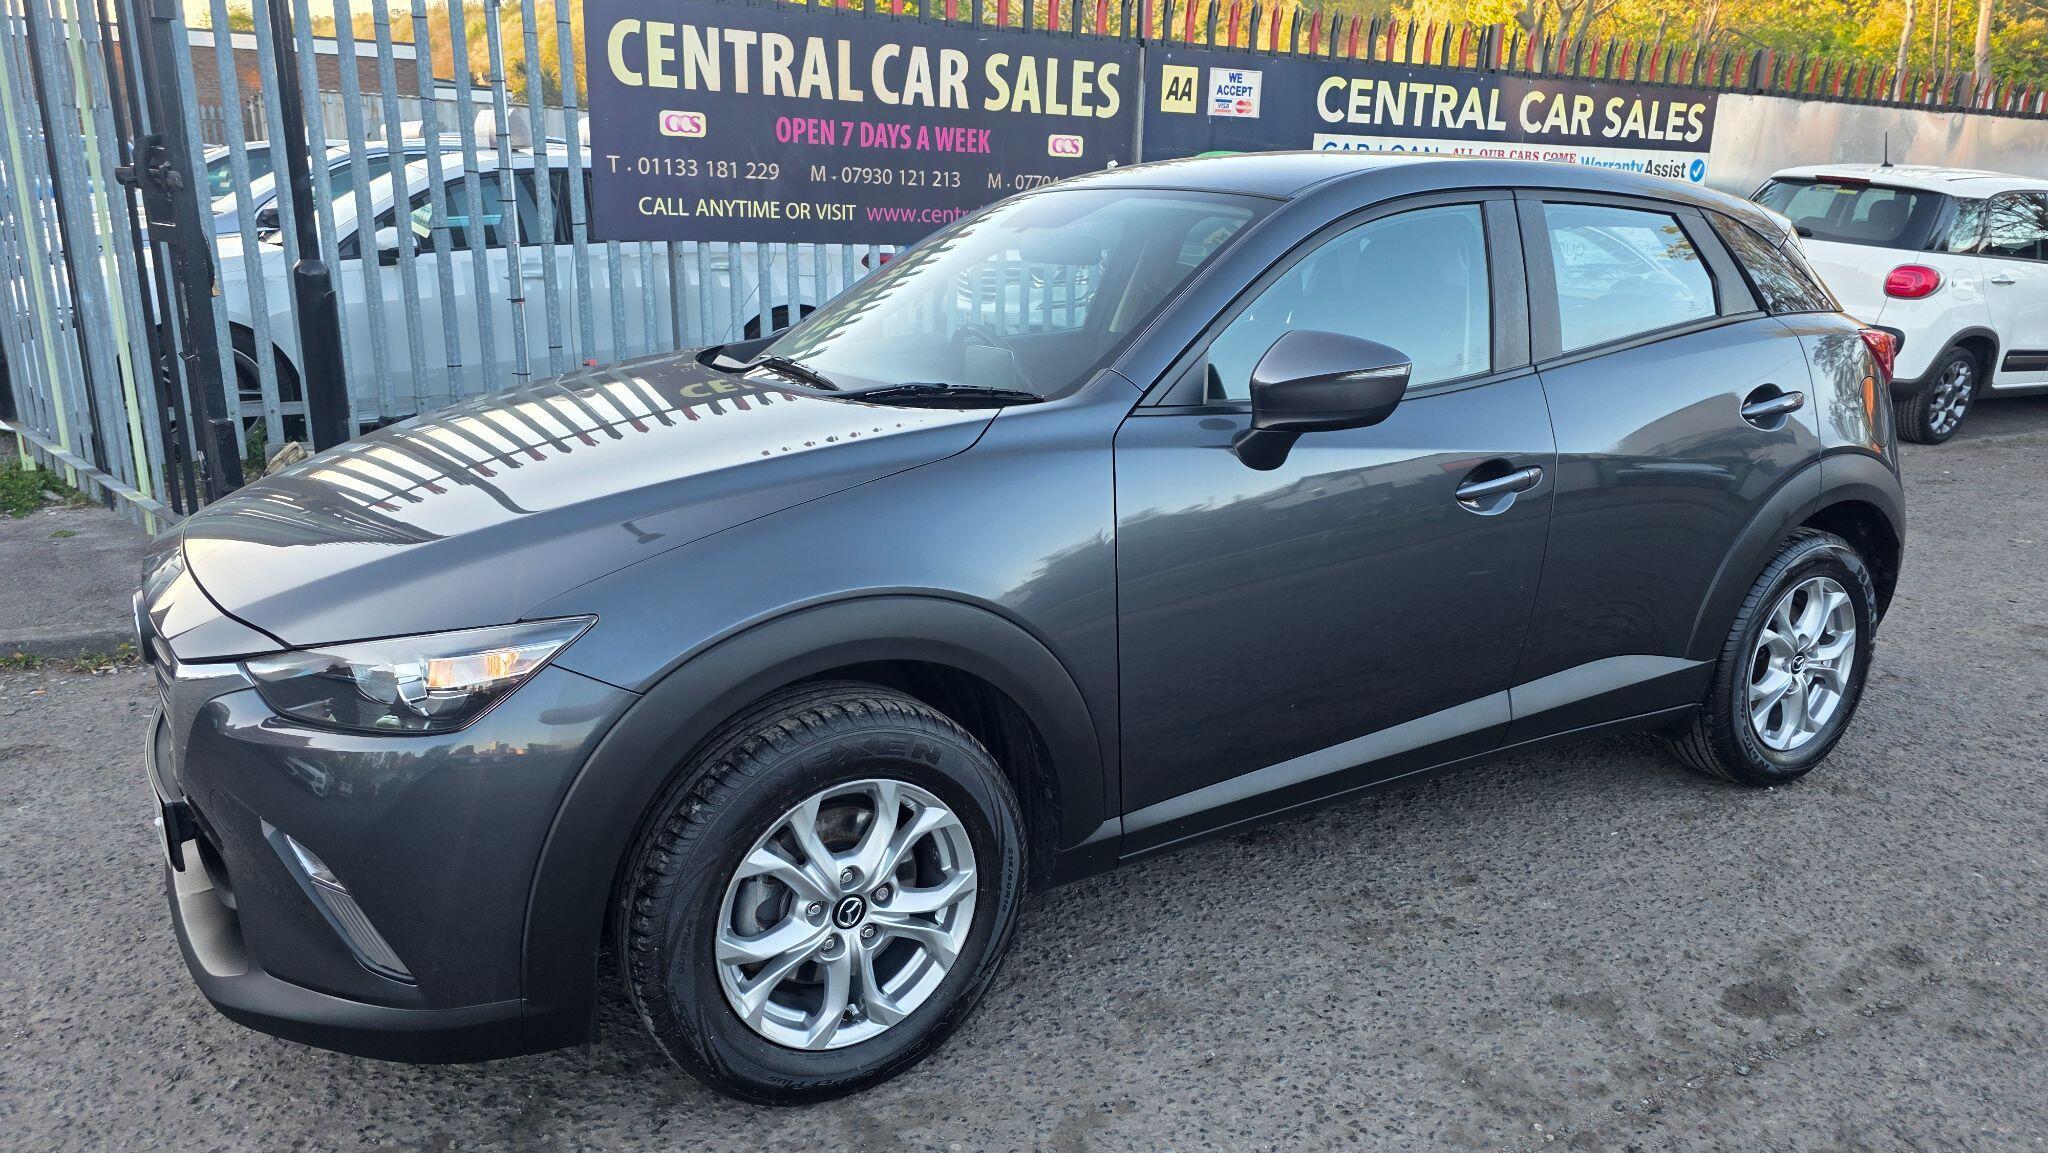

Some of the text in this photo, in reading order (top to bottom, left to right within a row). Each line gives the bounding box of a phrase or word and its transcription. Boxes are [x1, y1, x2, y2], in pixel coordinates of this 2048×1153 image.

[608, 19, 1120, 118] CENTRAL CAR SALES
[1229, 72, 1243, 83] WE
[1166, 76, 1192, 101] AA
[1216, 85, 1253, 97] ACCEPT
[1317, 76, 1706, 143] CENTRAL CAR SALES
[665, 114, 701, 134] CCS
[776, 116, 992, 153] OPEN 7 DAYS A WEEK
[1052, 138, 1080, 154] CCS
[1510, 150, 1540, 161] CARS
[638, 157, 698, 177] 01133
[706, 160, 737, 178] 181
[744, 162, 780, 180] 229
[841, 166, 892, 185] 07930
[899, 170, 925, 186] 121
[932, 171, 961, 187] 213
[638, 196, 974, 224] CALL ANYTIME OR VISIT www.centr
